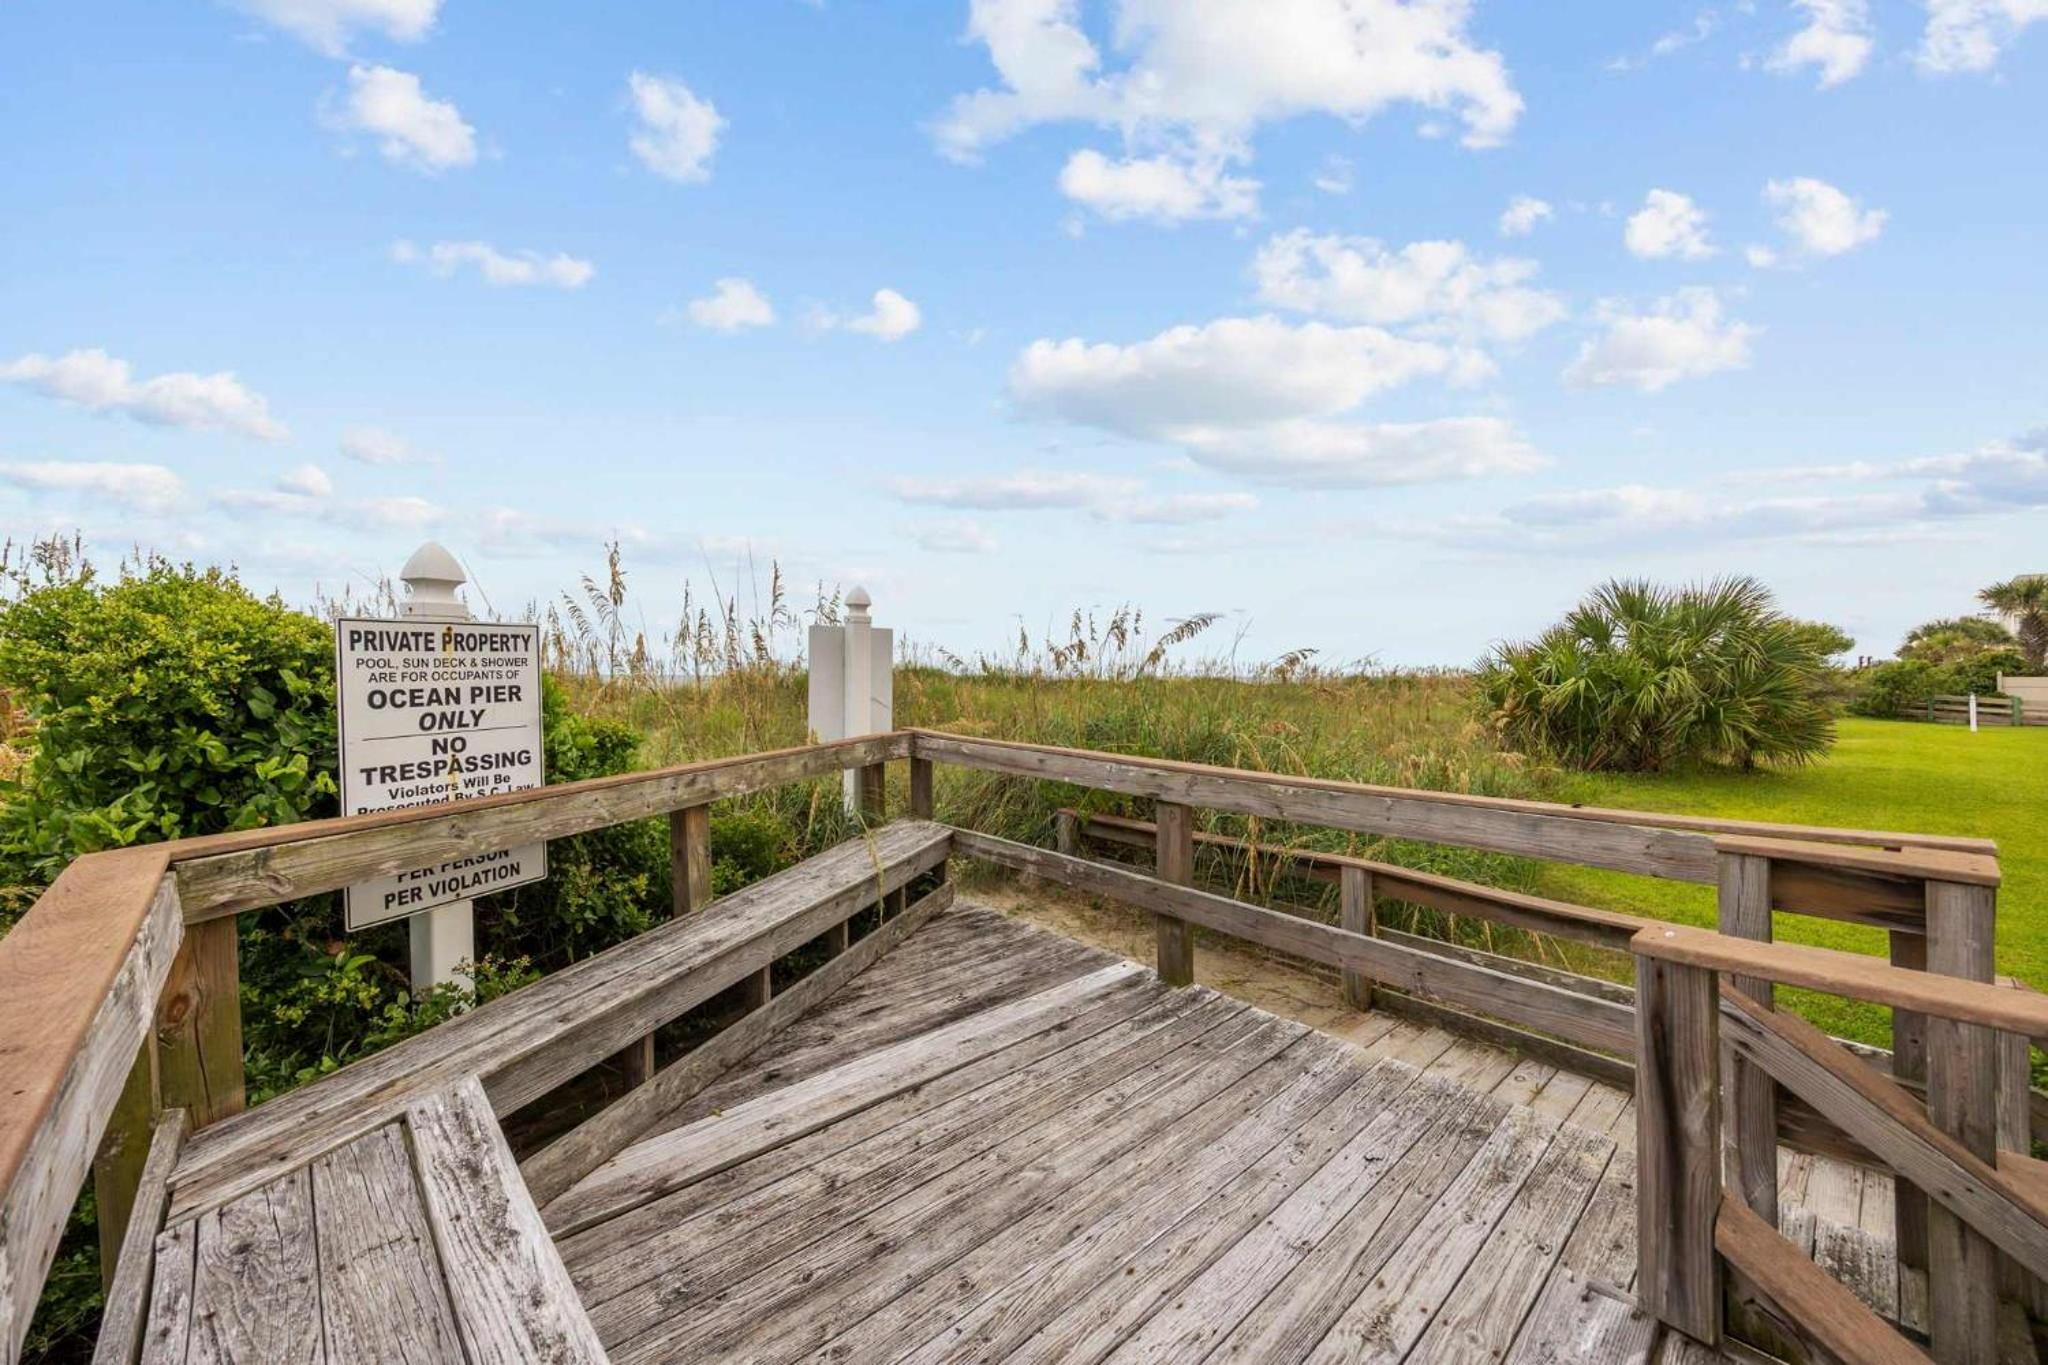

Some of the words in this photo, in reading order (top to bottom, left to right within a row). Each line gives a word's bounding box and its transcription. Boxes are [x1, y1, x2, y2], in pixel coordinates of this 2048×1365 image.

[349, 630, 435, 651] PRIVATE
[441, 631, 532, 652] PROPERTY
[356, 658, 399, 670] POOL,
[402, 658, 429, 668] SUN
[433, 657, 467, 668] DECK
[470, 657, 478, 668] &
[481, 657, 528, 668] SHOWER
[368, 672, 397, 683] ARE
[401, 671, 428, 682] FOR
[431, 670, 503, 682] OCCUPANTS
[506, 670, 520, 680] OF
[367, 687, 461, 709] OCEAN
[470, 685, 522, 704] PIER
[418, 709, 486, 731] ONLY
[432, 736, 467, 756] NO
[360, 750, 532, 786] TRESPASSING
[388, 782, 459, 800] Violators
[463, 775, 490, 789] Will
[493, 774, 511, 784] Be
[384, 886, 423, 910] PER
[428, 861, 521, 897] VIOLATION
